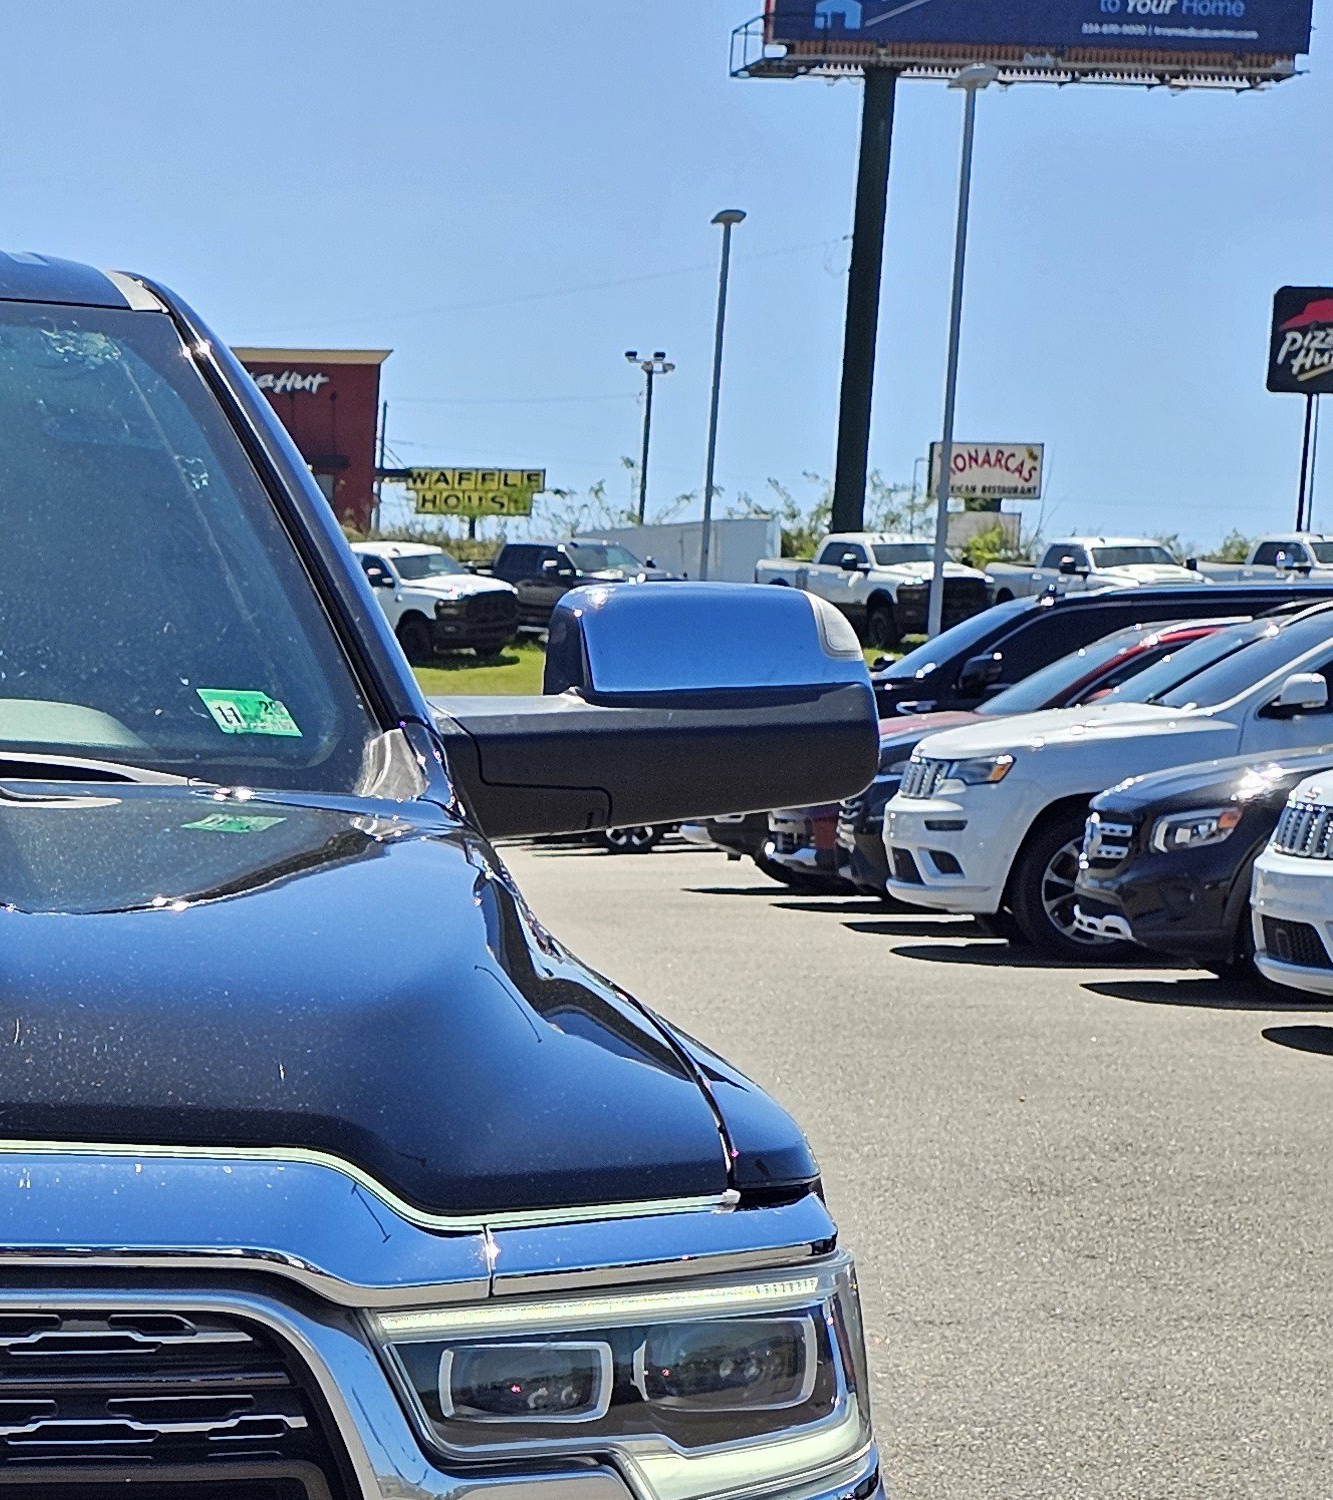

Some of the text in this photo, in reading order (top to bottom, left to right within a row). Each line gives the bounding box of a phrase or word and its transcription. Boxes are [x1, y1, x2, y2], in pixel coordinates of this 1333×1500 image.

[1100, 0, 1246, 17] to Your Home
[1276, 327, 1333, 365] Pizz
[1290, 347, 1333, 375] Hu
[949, 448, 1038, 482] ONARCAS
[411, 470, 541, 488] WAFFLE
[421, 493, 528, 511] HOUS
